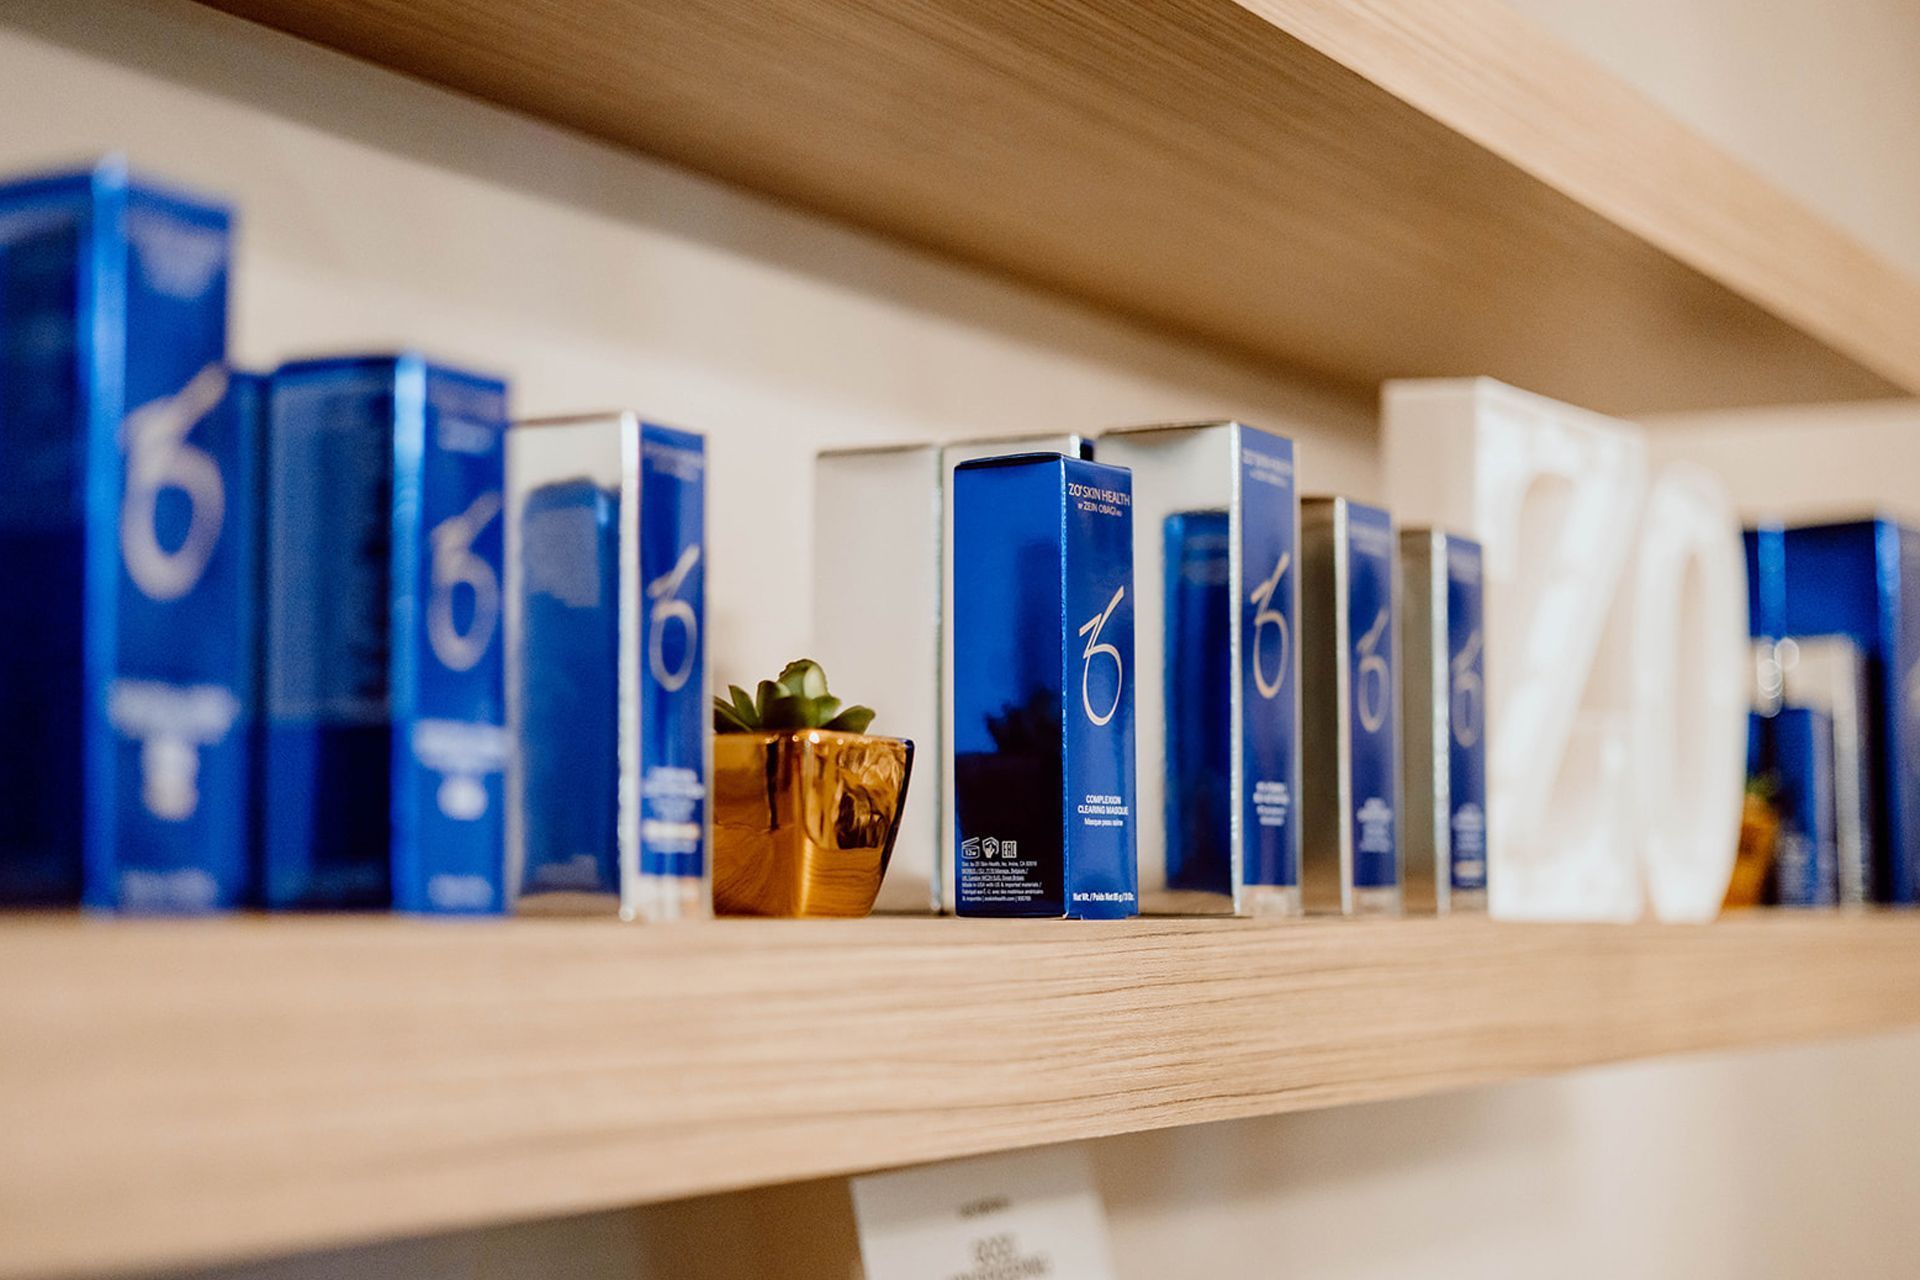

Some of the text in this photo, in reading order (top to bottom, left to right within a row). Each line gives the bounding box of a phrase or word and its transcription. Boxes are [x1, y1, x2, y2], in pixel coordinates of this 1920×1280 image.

[1083, 486, 1101, 500] SKIN
[1101, 490, 1130, 505] HEALTH
[1086, 795, 1121, 804] COMPLEXION
[1078, 805, 1128, 815] CLEARING MASQUE
